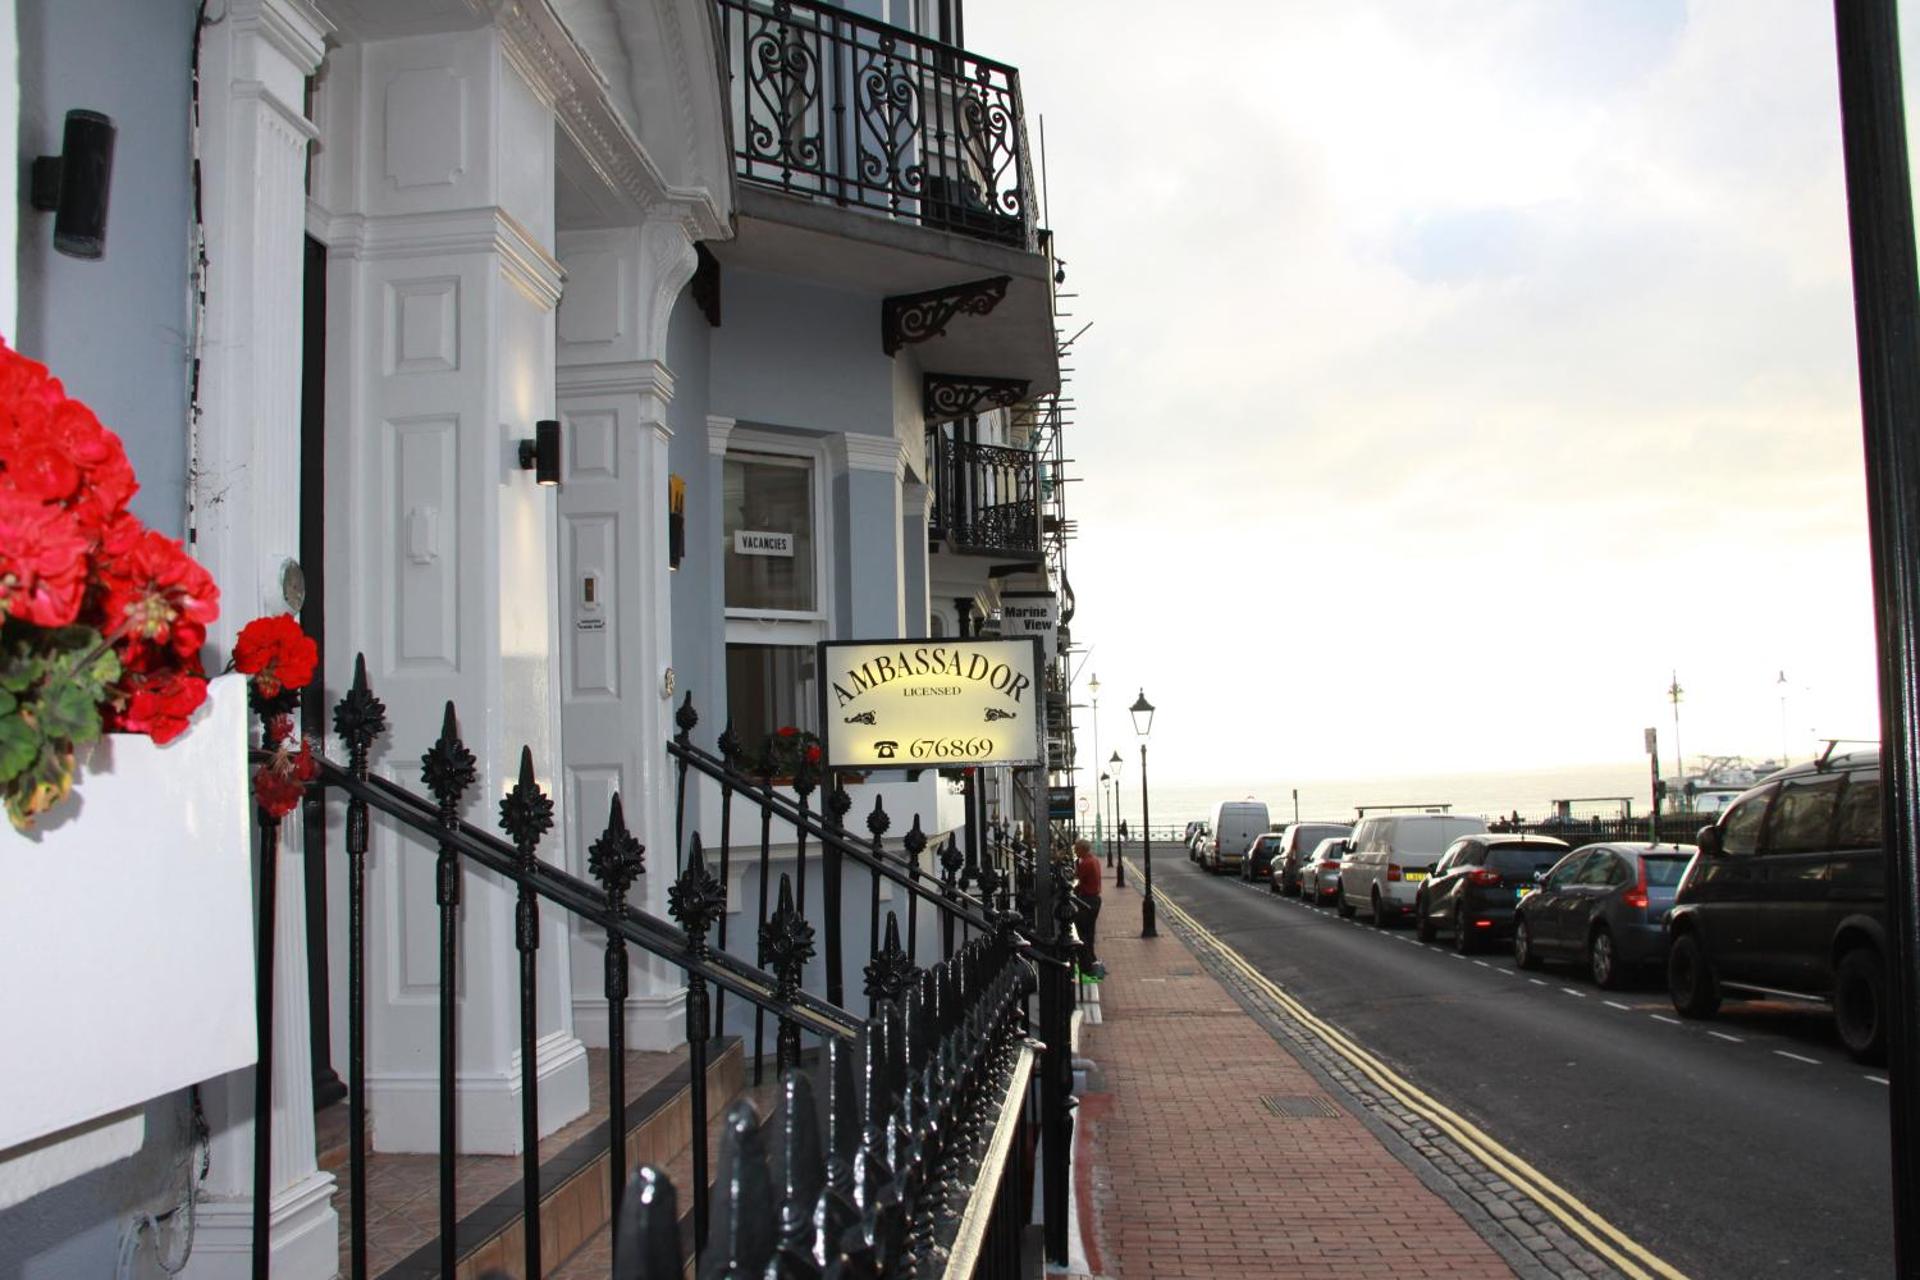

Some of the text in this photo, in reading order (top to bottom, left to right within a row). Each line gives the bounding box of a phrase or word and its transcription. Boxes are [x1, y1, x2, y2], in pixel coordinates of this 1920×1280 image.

[742, 535, 787, 550] VACANCIES
[1004, 606, 1047, 618] Marine
[1024, 619, 1052, 631] View
[832, 648, 1030, 708] AMBASSADOR
[903, 687, 962, 697] LICENSED
[909, 737, 993, 759] 676869
